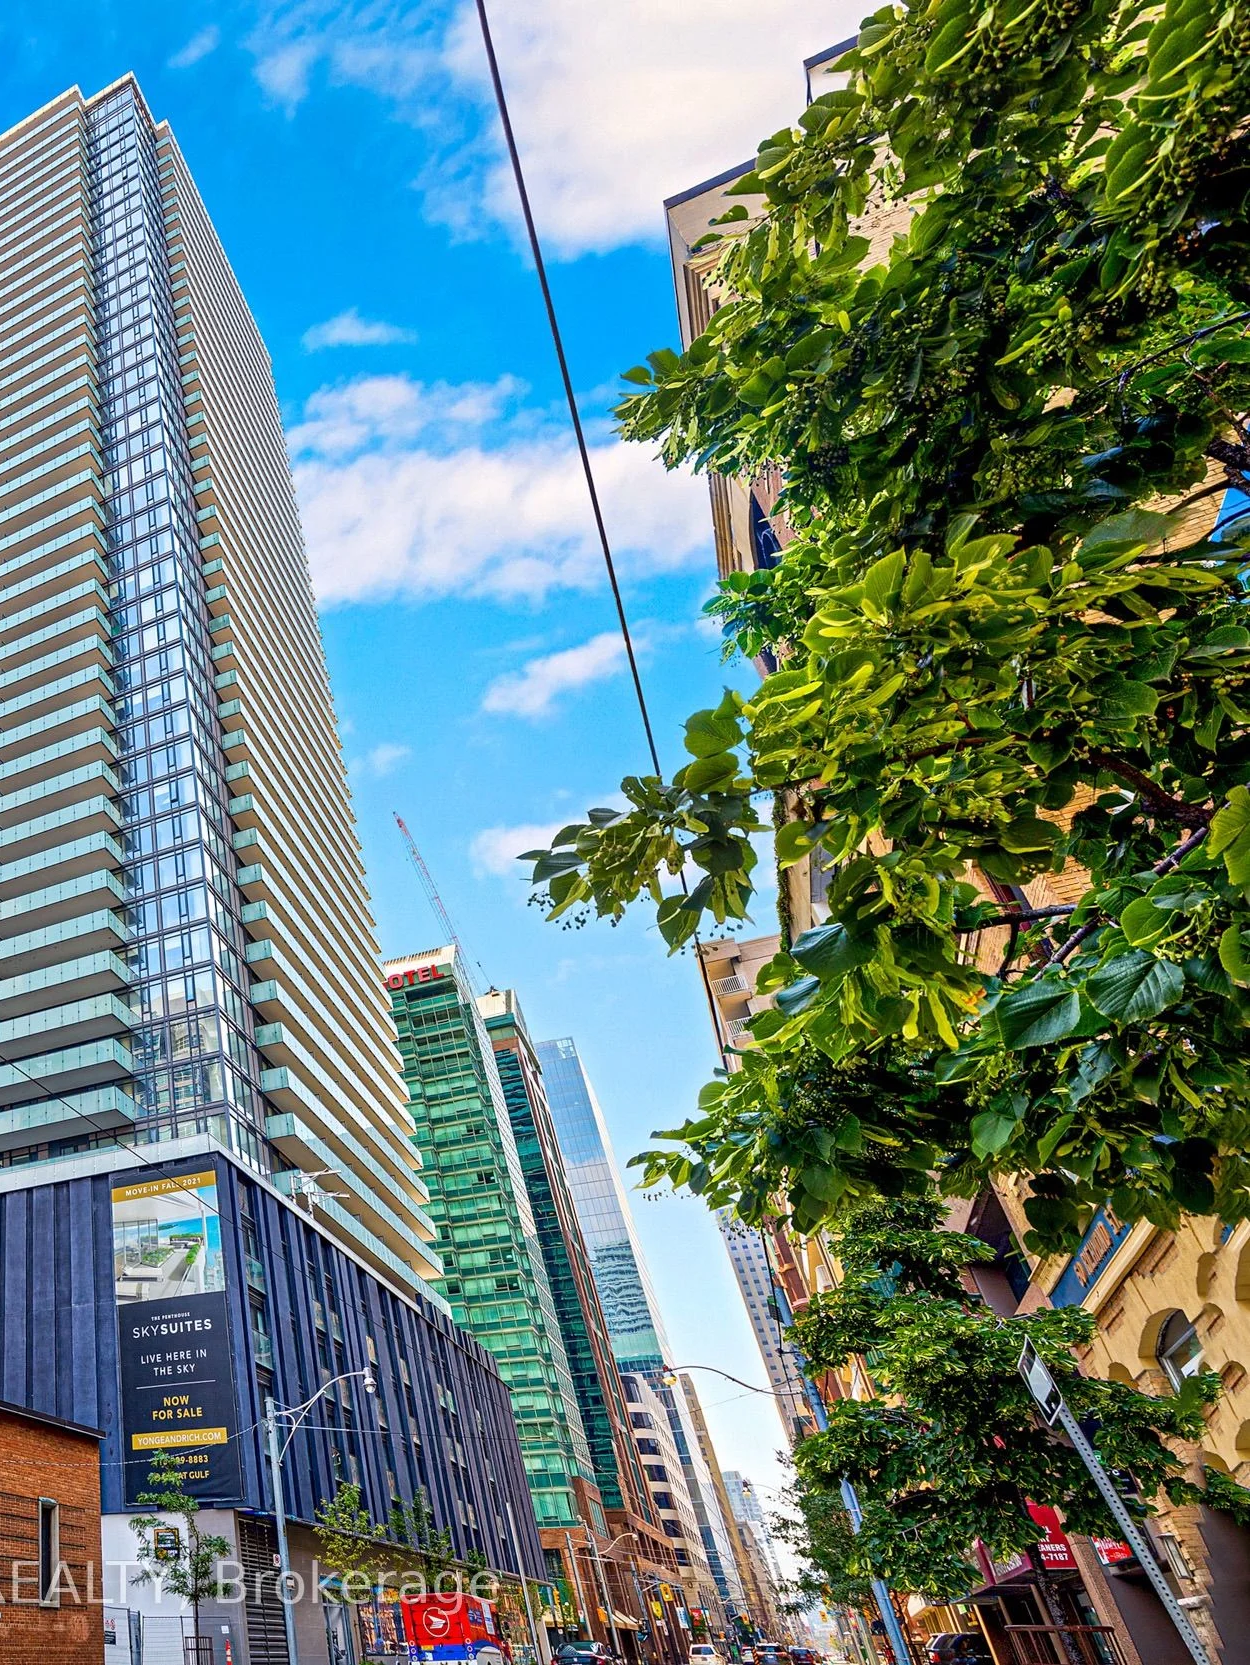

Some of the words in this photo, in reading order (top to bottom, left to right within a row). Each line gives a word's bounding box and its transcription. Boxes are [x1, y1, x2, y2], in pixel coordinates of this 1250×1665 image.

[125, 1184, 159, 1196] MOVE-IN
[182, 1177, 201, 1186] 2021
[162, 1312, 190, 1320] PENTHOUSE
[132, 1319, 212, 1339] SKYSUITES
[140, 1353, 162, 1364] LIVE
[165, 1350, 192, 1361] HERE
[196, 1349, 207, 1358] IN
[153, 1366, 172, 1376] THE
[177, 1363, 196, 1373] SKY
[163, 1395, 190, 1406] NOW
[152, 1409, 173, 1420] FOR
[176, 1407, 203, 1419] SALE
[137, 1432, 222, 1446] YONGEANDRICH.COM
[188, 1470, 210, 1479] GULF
[1037, 1543, 1067, 1552] EANERS
